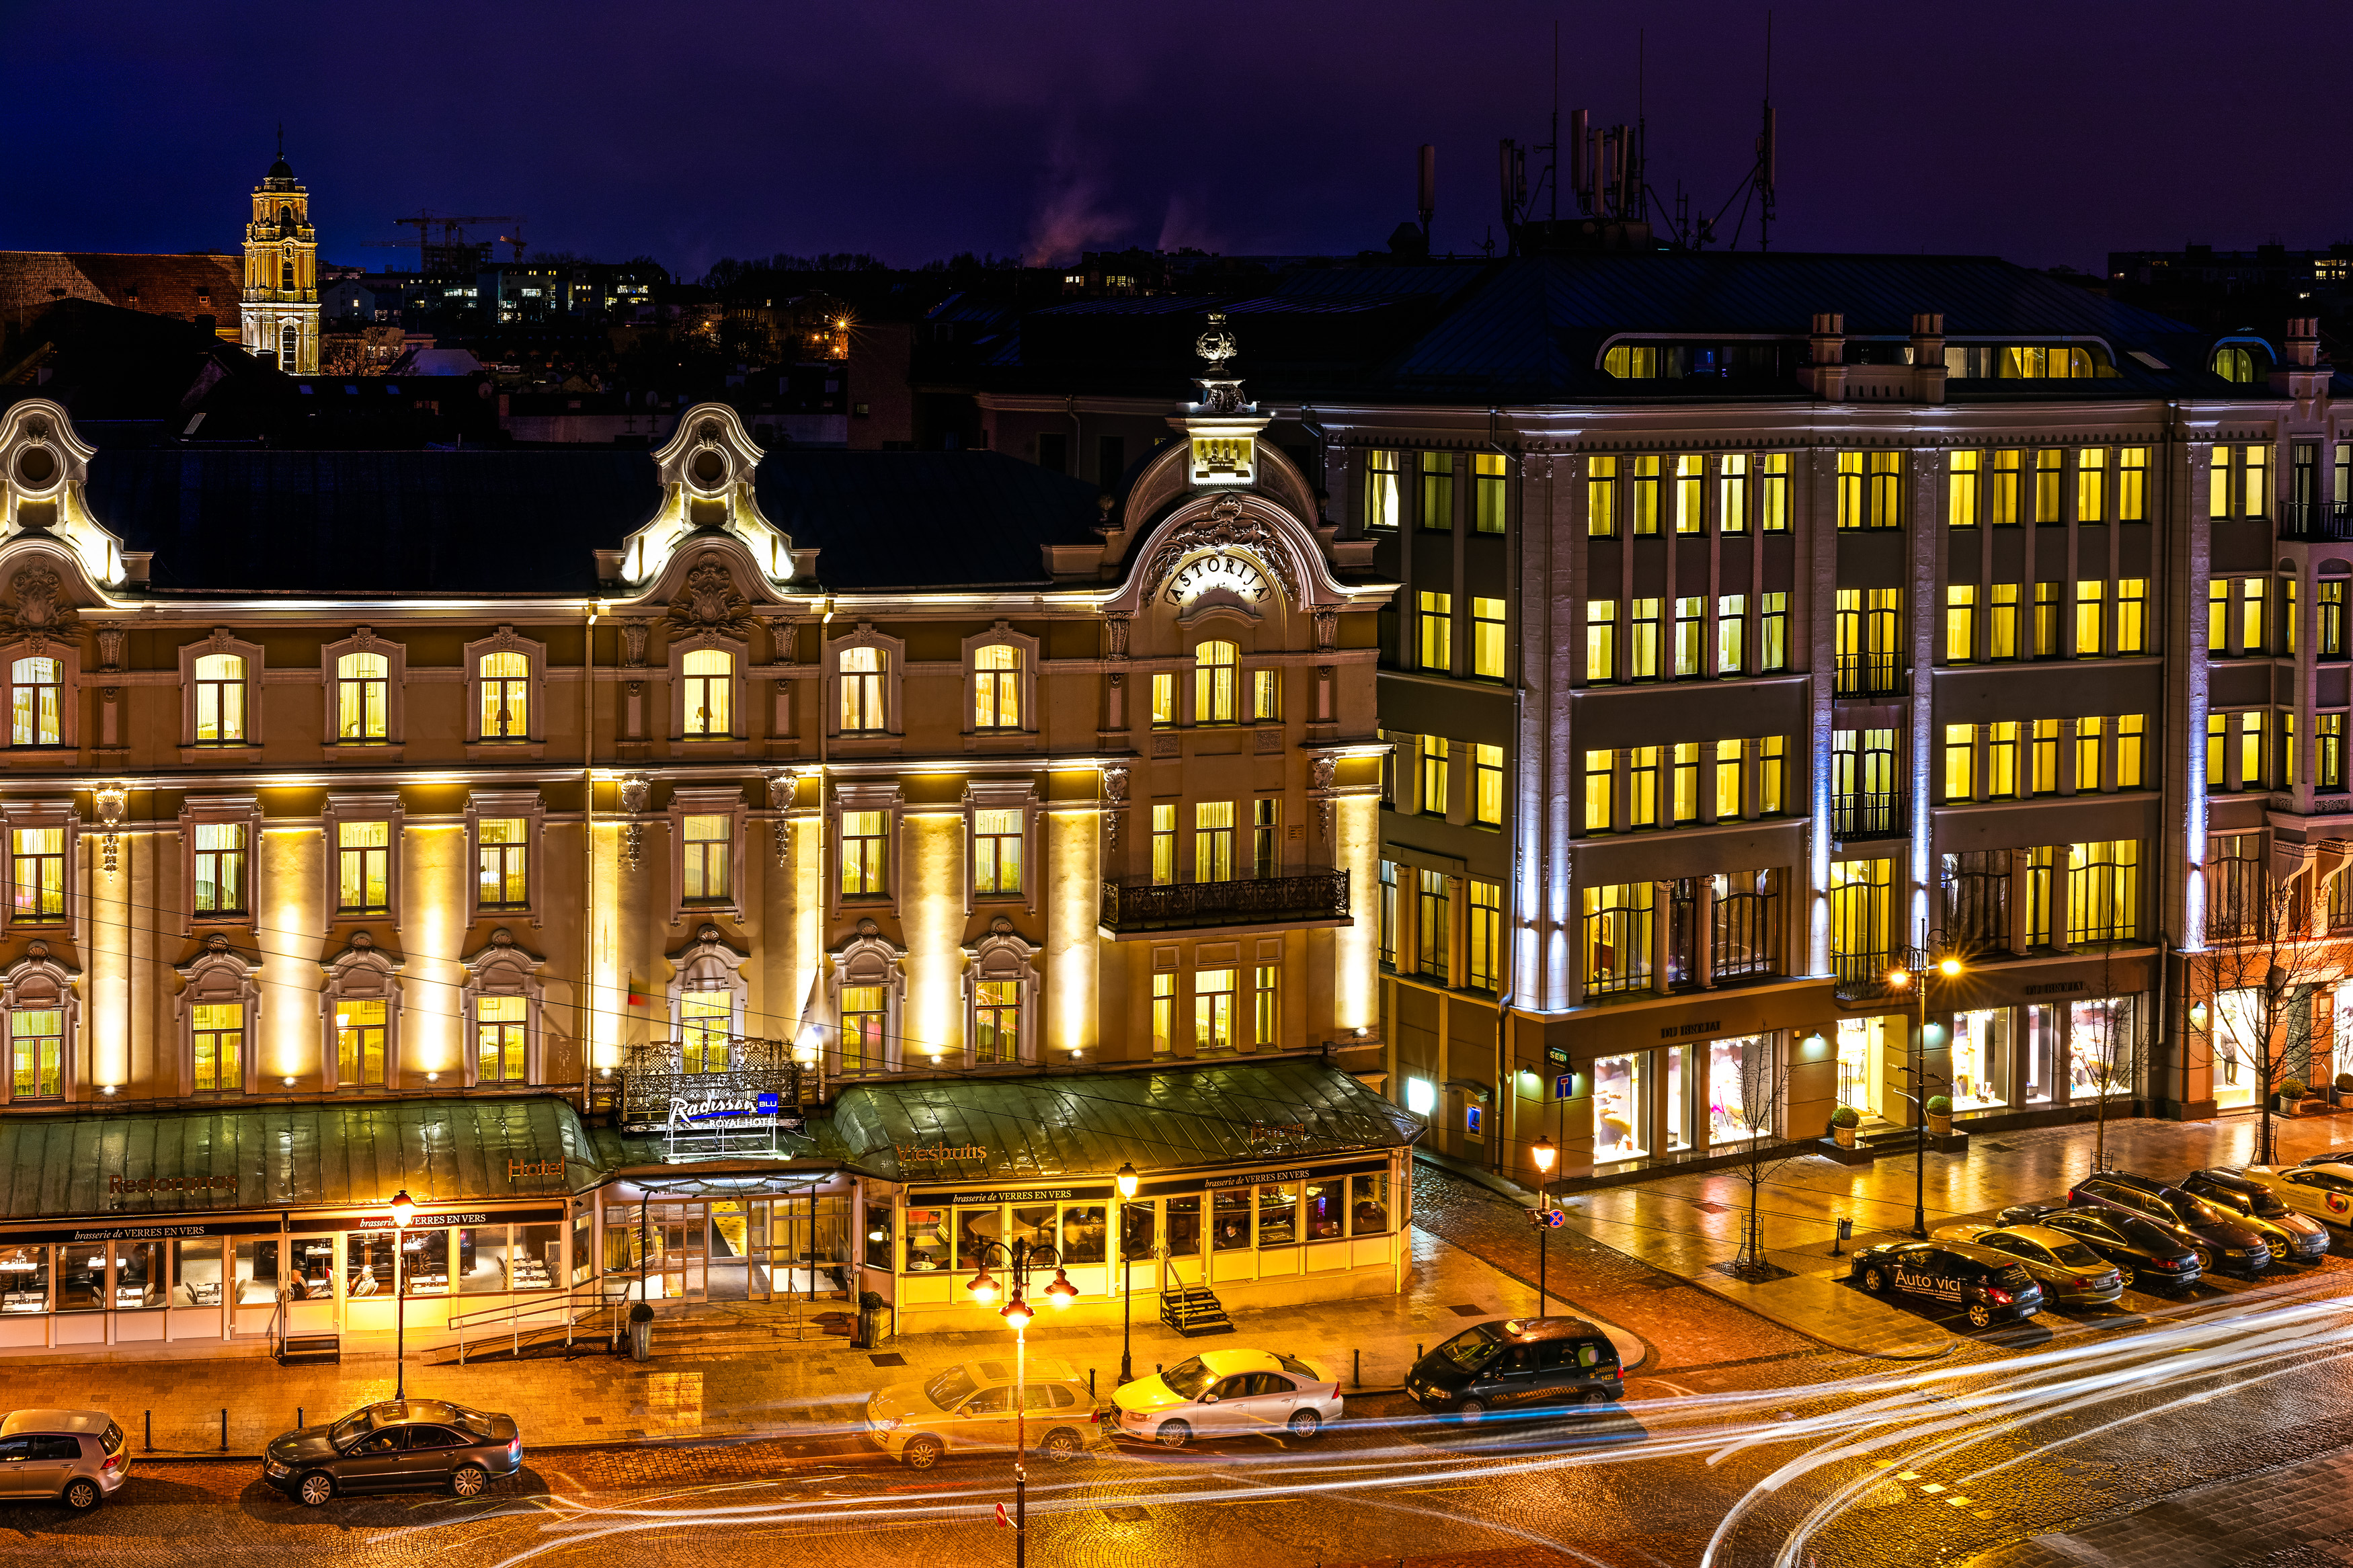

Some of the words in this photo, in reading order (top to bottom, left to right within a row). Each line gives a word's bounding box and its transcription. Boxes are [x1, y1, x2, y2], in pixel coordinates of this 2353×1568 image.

[1200, 446, 1240, 462] 1901
[1169, 557, 1268, 603] ASTORIJA
[1661, 1027, 1678, 1038] DU
[1550, 1051, 1564, 1061] SEB
[669, 1091, 758, 1126] Radisson
[709, 1119, 744, 1128] ROYAL
[745, 1118, 779, 1126] HOTEL
[508, 1155, 565, 1177] Hotel
[109, 1174, 237, 1194] Restoranas
[1205, 1178, 1234, 1188] brasserie
[1236, 1176, 1244, 1185] de
[1245, 1173, 1276, 1184] VERRES
[1277, 1172, 1288, 1180] EN
[1289, 1170, 1310, 1179] VERS
[953, 1194, 986, 1202] brasserie
[988, 1193, 997, 1201] de
[998, 1192, 1033, 1200] VERRES
[360, 1217, 395, 1229] brasserie
[410, 1214, 445, 1225] VERRES
[447, 1214, 460, 1224] EN
[461, 1214, 486, 1223] VERS
[75, 1230, 111, 1240] brasserie
[113, 1229, 123, 1239] de
[124, 1229, 162, 1237] VERRES
[164, 1227, 177, 1236] EN
[180, 1226, 204, 1235] VERS
[1895, 1270, 1931, 1287] Auto
[1936, 1276, 1960, 1291] vici
[1595, 1365, 1617, 1374] 2400004
